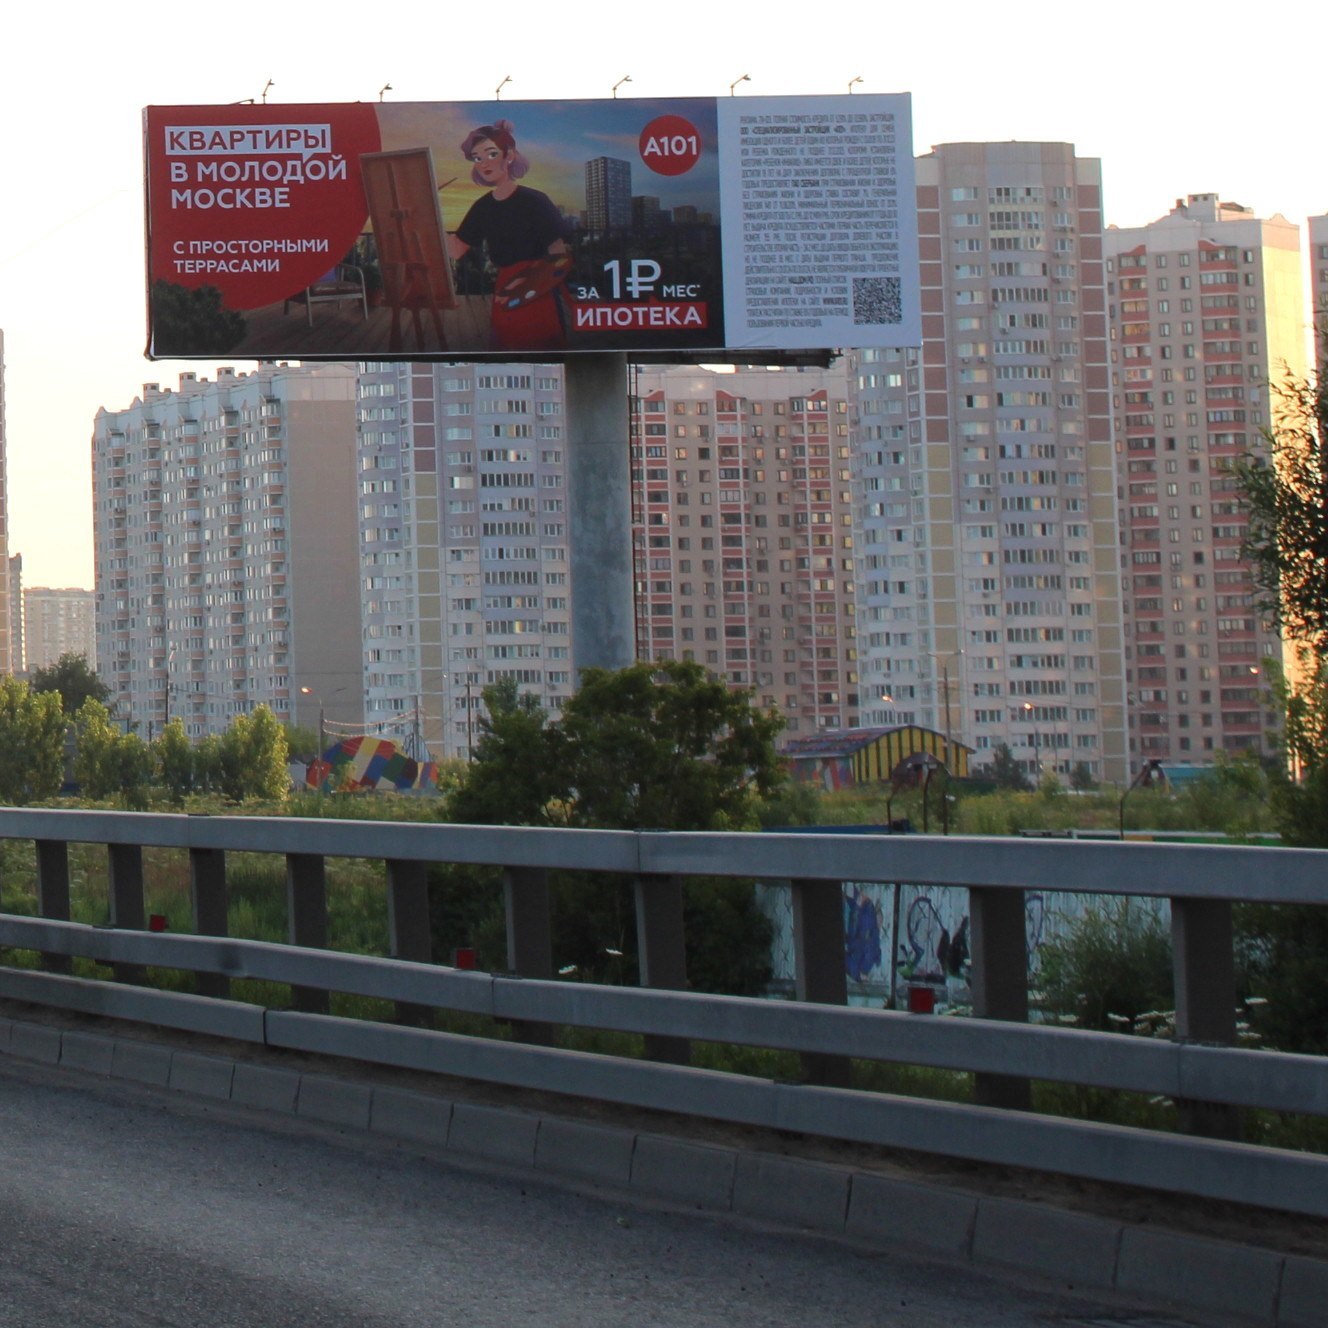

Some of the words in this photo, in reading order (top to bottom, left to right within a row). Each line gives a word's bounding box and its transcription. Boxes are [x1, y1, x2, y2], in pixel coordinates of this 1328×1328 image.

[169, 129, 326, 151] КВАРТИРЫ
[643, 135, 697, 156] А101
[170, 162, 189, 183] В
[197, 154, 347, 184] МОЛОДОЙ
[171, 187, 291, 209] МОСКВЕ
[173, 240, 185, 254] С
[189, 239, 329, 254] ПРОСТОРНЫМИ
[173, 259, 280, 274] ТЕРРАСАМИ
[577, 287, 600, 299] ЗА
[576, 306, 703, 327] ИПОТЕКА
